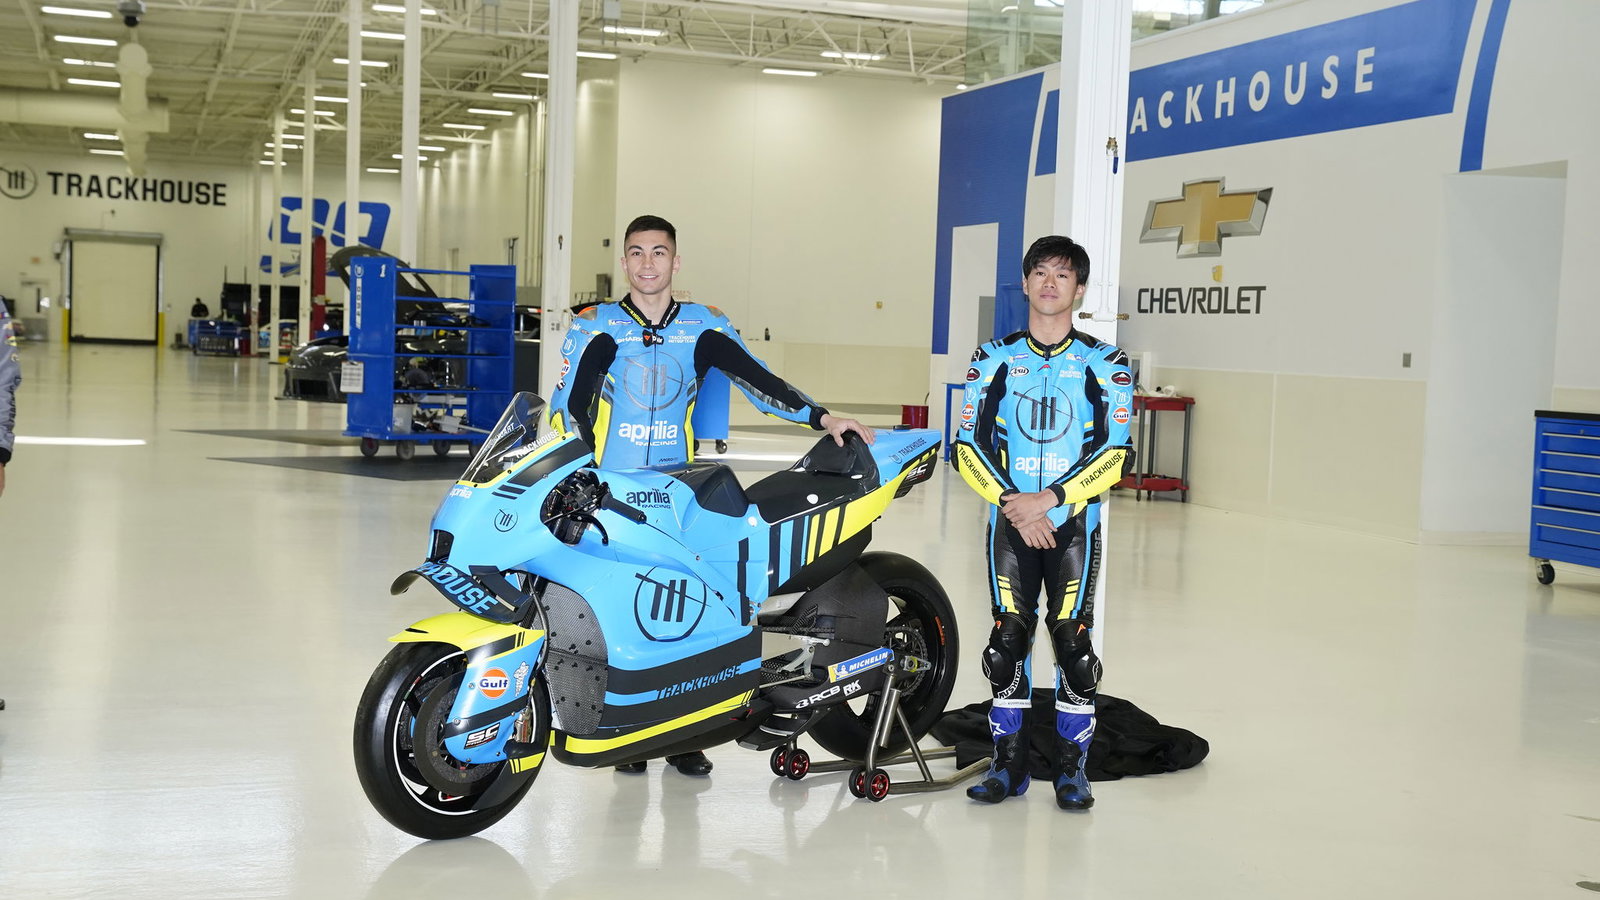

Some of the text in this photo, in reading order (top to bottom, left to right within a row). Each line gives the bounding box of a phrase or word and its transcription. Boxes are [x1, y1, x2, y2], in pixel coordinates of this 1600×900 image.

[1129, 47, 1375, 135] ACKHOUSE
[46, 171, 227, 206] TRACKHOUSE
[1137, 286, 1267, 314] CHEVROLET
[618, 420, 678, 442] aprilia
[958, 445, 990, 490] TRACKHOUSE
[1014, 452, 1070, 474] aprilia
[1079, 452, 1124, 489] TRACKHOUSE
[626, 488, 671, 506] aprilia
[849, 651, 888, 672] MICHELIN
[480, 678, 508, 688] Gulf
[657, 663, 744, 700] TRACKHOUSE
[842, 679, 861, 697] RK
